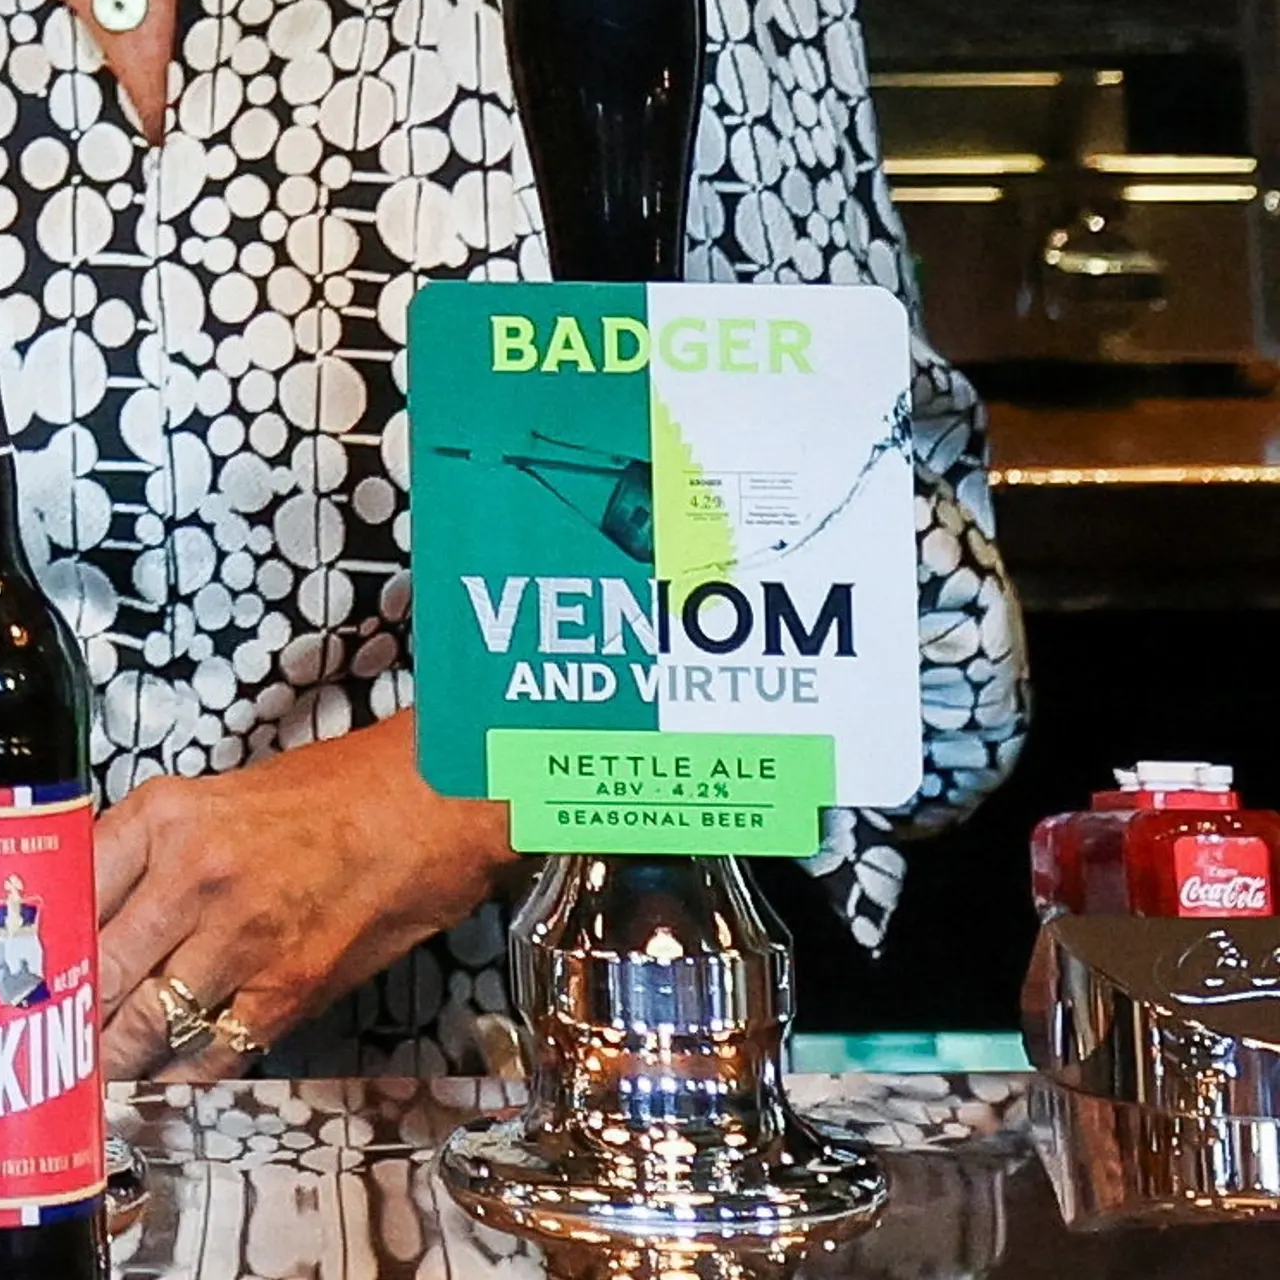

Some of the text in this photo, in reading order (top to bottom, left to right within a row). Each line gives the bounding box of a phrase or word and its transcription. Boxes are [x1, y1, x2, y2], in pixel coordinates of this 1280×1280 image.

[490, 314, 815, 376] BADGER
[461, 575, 858, 659] VENOM
[504, 660, 820, 705] AND VIRTUE
[547, 754, 777, 780] NETTLE ALE
[596, 781, 730, 800] ABV 4.2%
[557, 809, 764, 829] SEASONAL BEER
